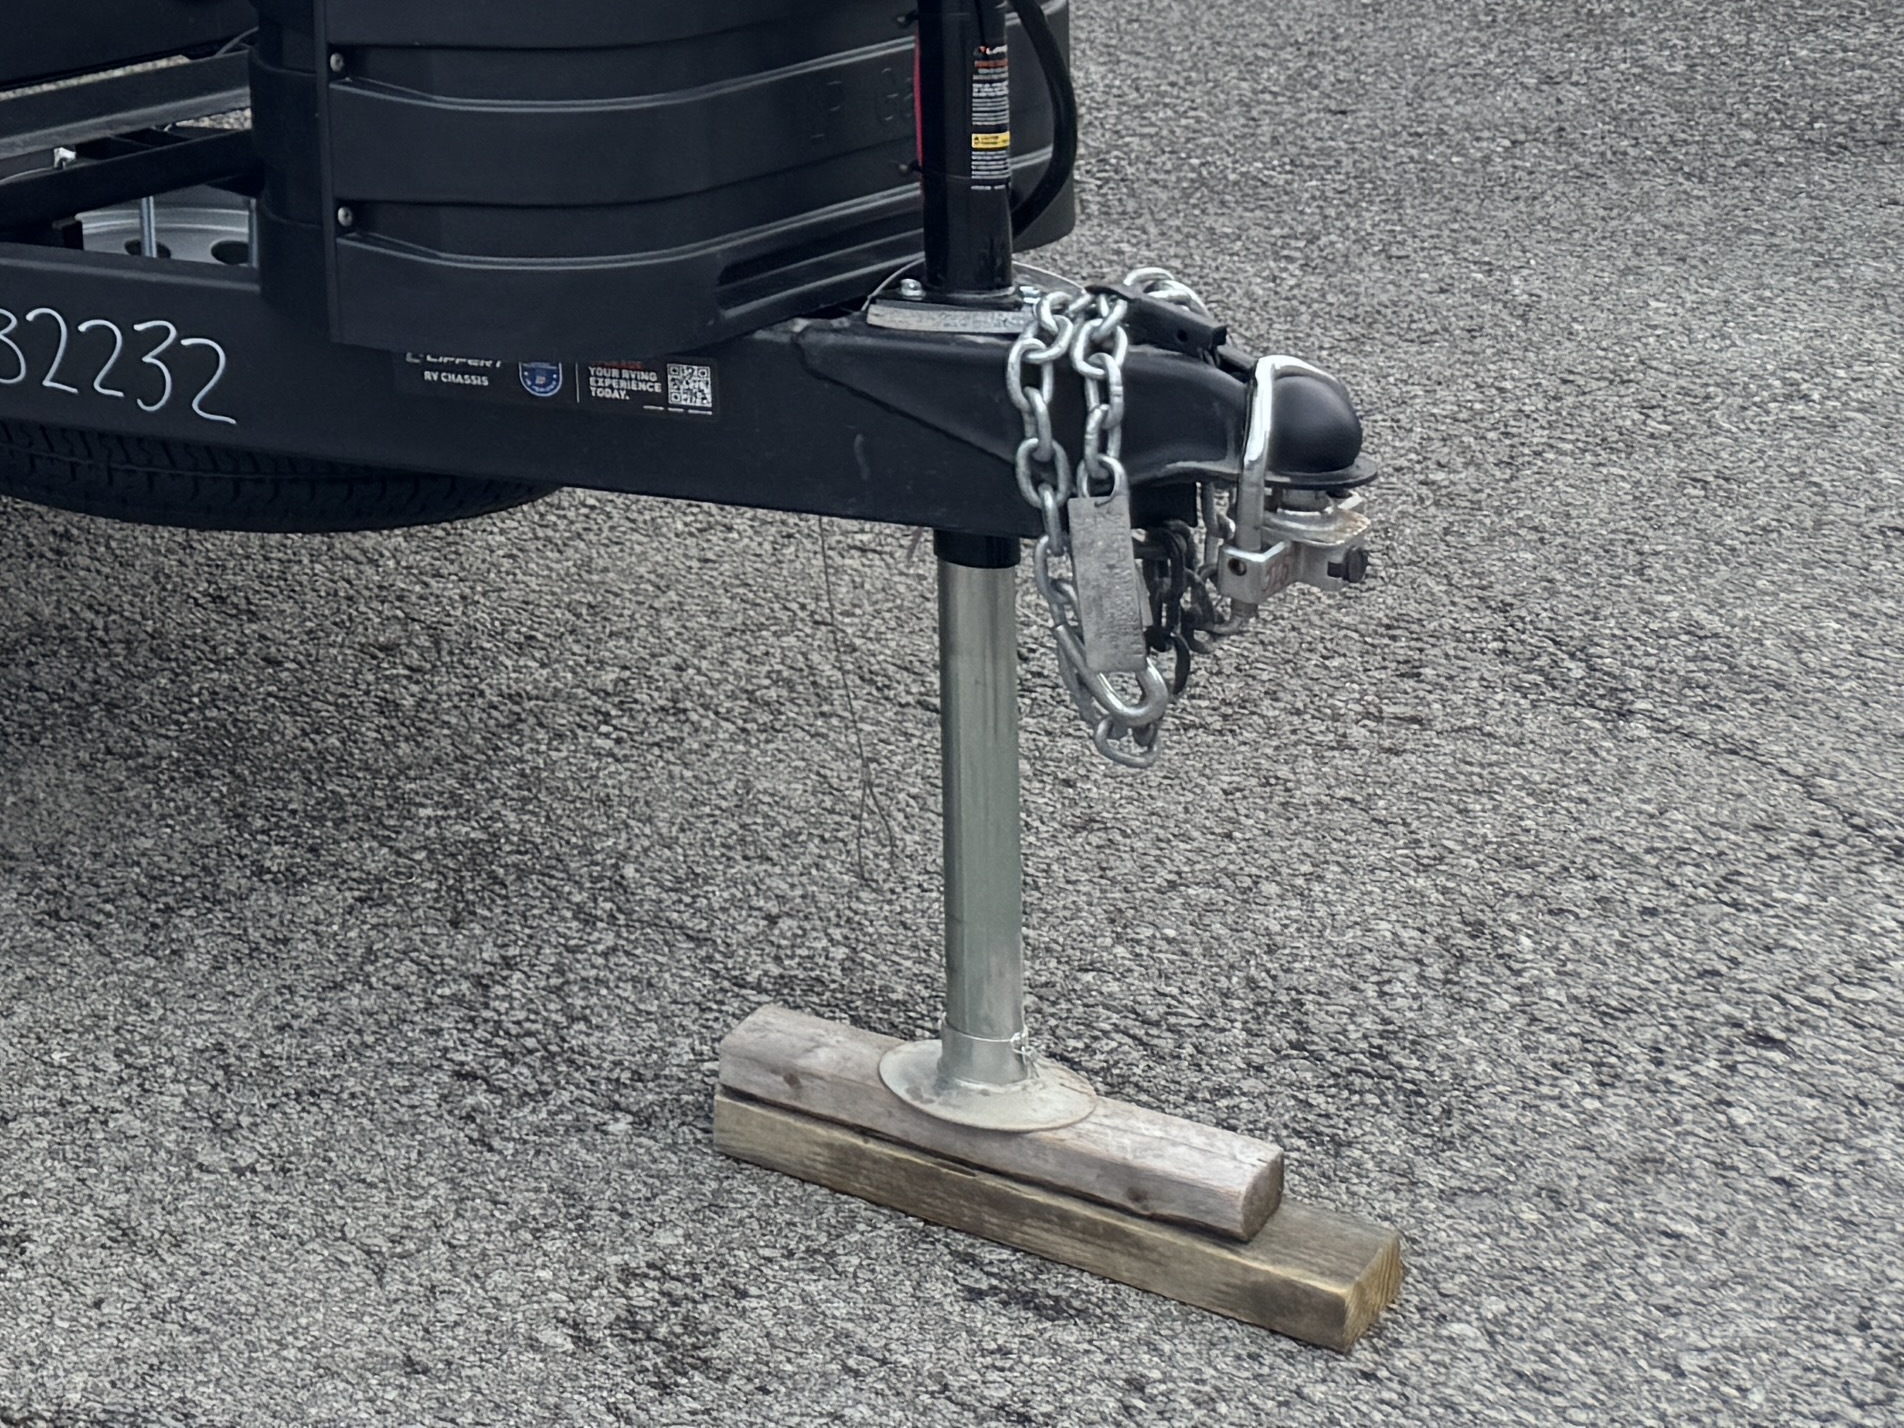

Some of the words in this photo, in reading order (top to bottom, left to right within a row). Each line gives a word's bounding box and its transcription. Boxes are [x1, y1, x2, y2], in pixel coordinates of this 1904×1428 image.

[423, 370, 439, 382] RV
[440, 371, 489, 386] CHASSIS
[588, 365, 620, 378] YOUR
[588, 376, 662, 393] EXPERIENCE
[589, 386, 630, 401] TODAY.
